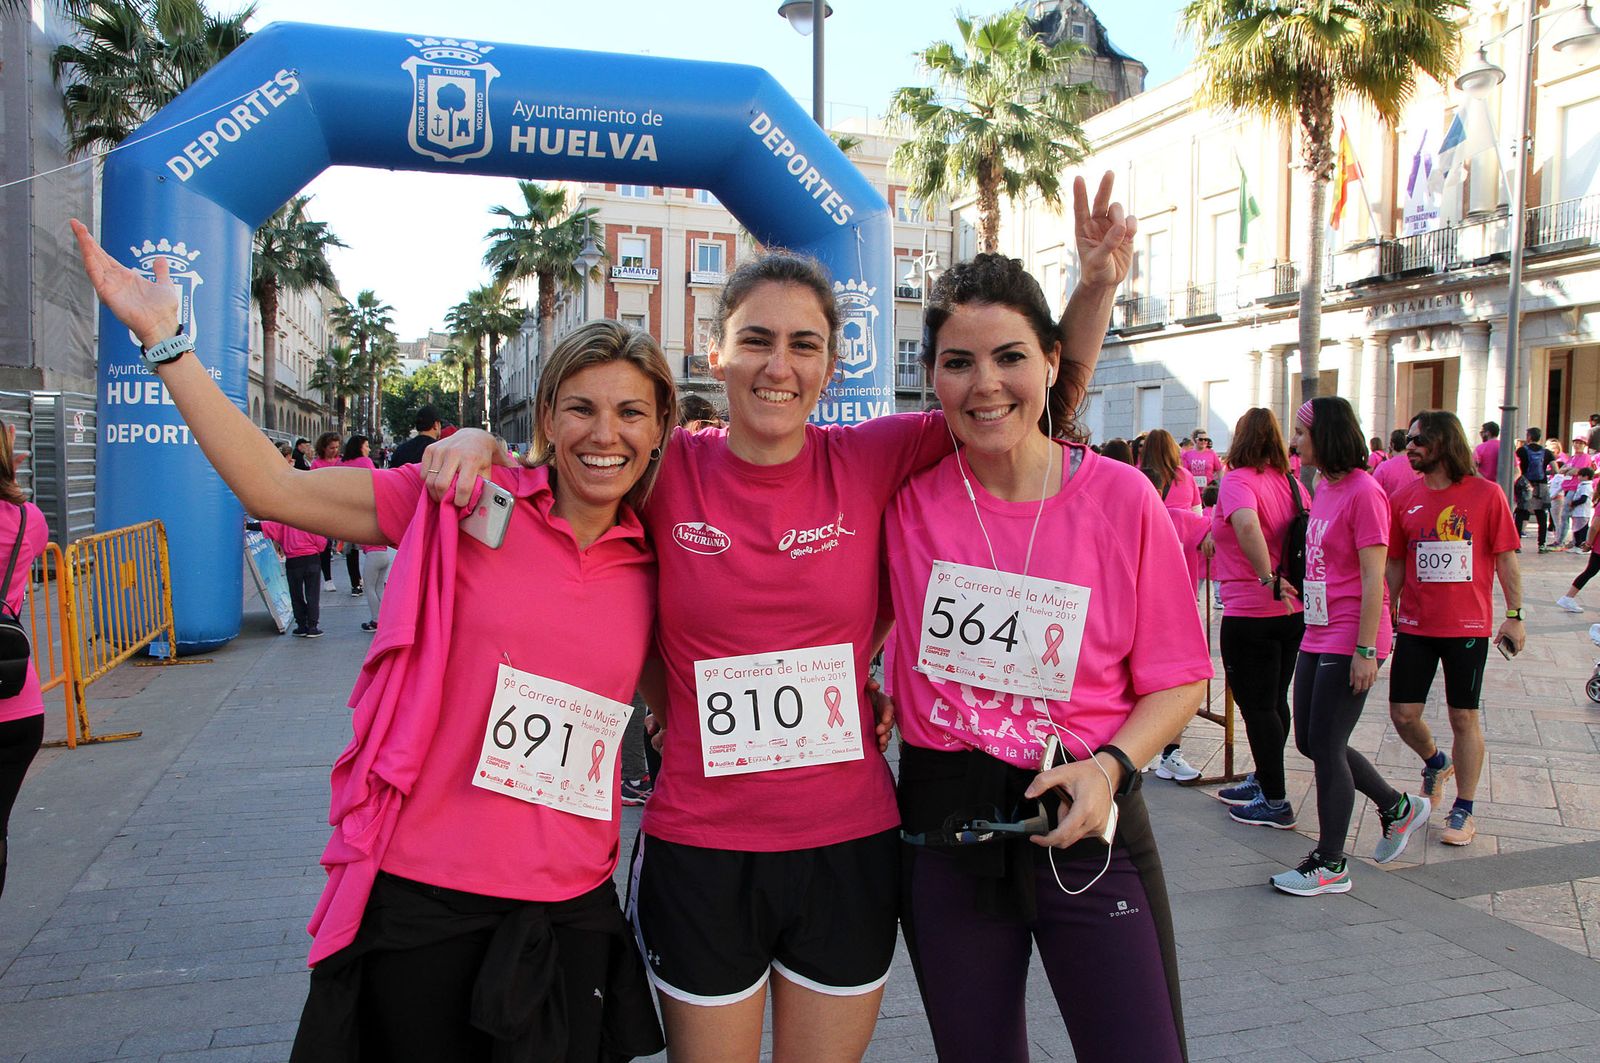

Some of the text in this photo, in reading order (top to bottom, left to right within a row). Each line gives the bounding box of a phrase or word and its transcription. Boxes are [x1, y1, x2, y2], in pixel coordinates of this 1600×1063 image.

[476, 92, 484, 131] CUSTODIA
[512, 99, 663, 127] Ayuntamiento de
[166, 68, 301, 183] DEPORTES
[509, 125, 658, 162] HUELVA
[749, 112, 854, 226] DEPORTES
[622, 267, 657, 276] AMATUR
[1366, 291, 1474, 318] AYUNTAMIENTO
[676, 526, 726, 547] ASTURIANA
[797, 523, 835, 544] asics
[1418, 553, 1453, 569] 809
[954, 576, 1002, 595] Carrera
[1005, 586, 1021, 599] de
[1025, 589, 1038, 602] la
[1041, 593, 1080, 610] Mujer
[928, 596, 1019, 653] 564
[1025, 605, 1077, 621] Huelva 2019
[723, 667, 773, 680] Carrera
[777, 661, 793, 675] de
[797, 660, 808, 673] la
[812, 658, 846, 673] Mujer
[800, 672, 847, 684] Huelva 2019
[519, 684, 566, 709] Carrera
[569, 701, 582, 713] de
[583, 704, 592, 717] la
[595, 710, 621, 728] Mujer
[707, 685, 804, 735] 810
[493, 705, 574, 767] 691
[581, 720, 616, 738] Huelva 2019
[984, 743, 1000, 756] de
[1005, 746, 1017, 758] la
[1109, 907, 1140, 918] DOMYOS
